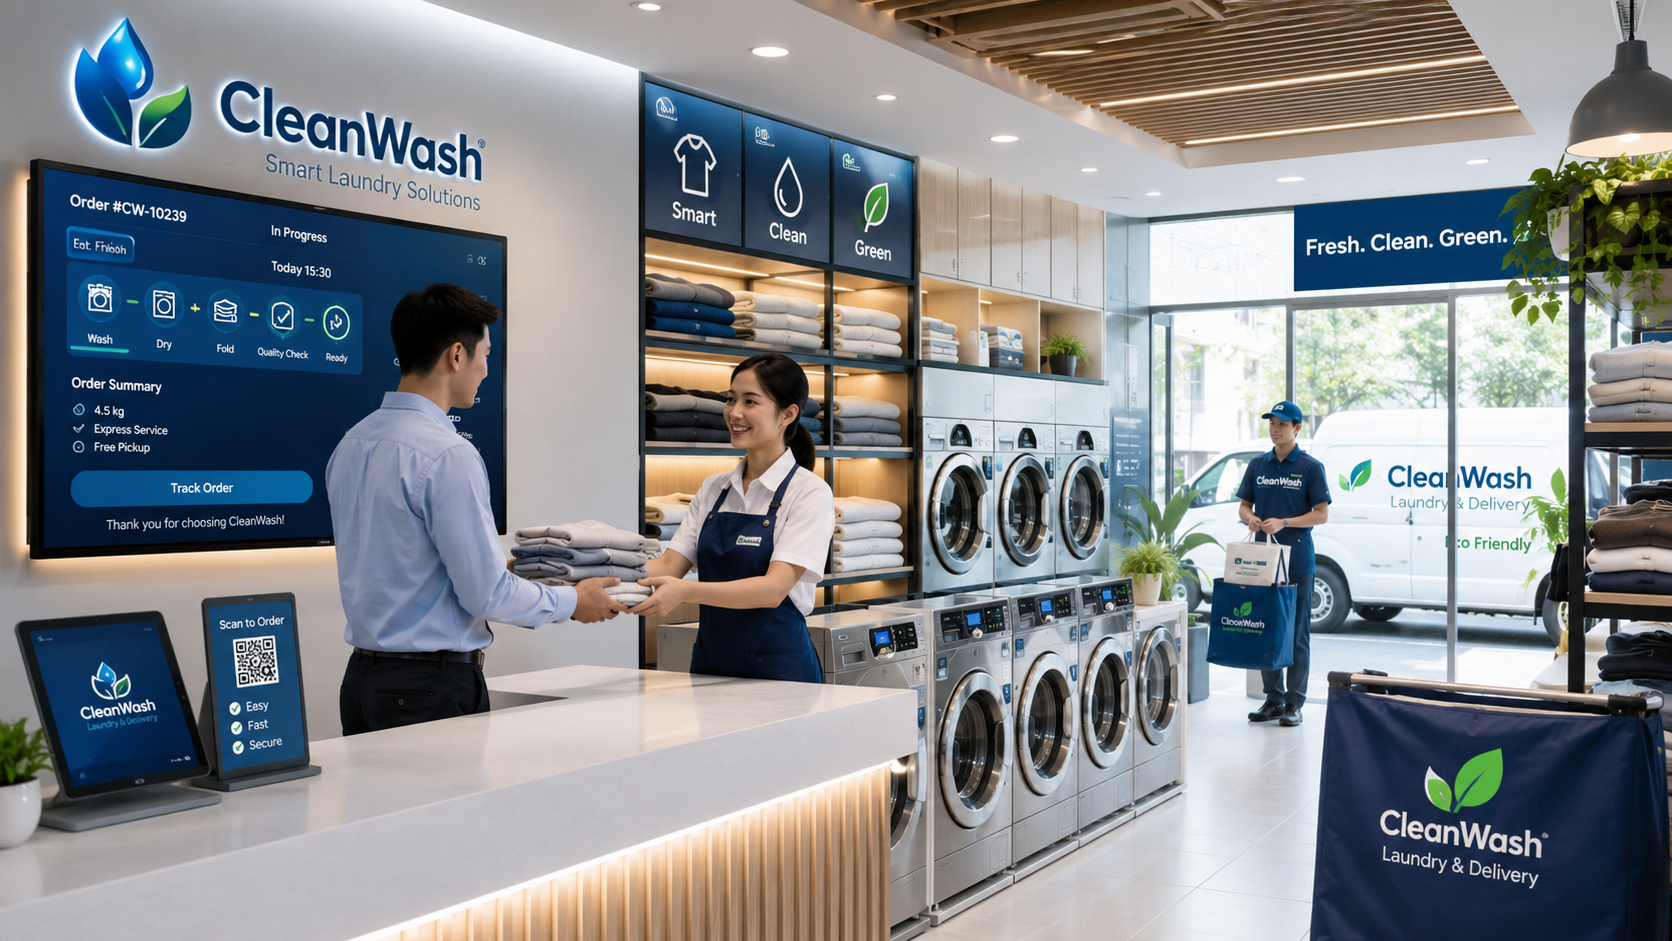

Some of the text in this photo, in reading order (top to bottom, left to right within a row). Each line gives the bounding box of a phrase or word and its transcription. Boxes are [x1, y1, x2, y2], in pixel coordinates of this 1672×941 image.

[266, 153, 481, 211] Smart Laundry Solutions
[69, 193, 187, 223] Order #CW-10239
[672, 201, 717, 227] Smart
[271, 224, 328, 244] In Progress
[769, 221, 807, 245] Clean
[1306, 228, 1508, 256] Fresh. Clean. Green.
[854, 239, 892, 262] Green
[271, 260, 332, 279] Today 15:30
[87, 333, 113, 345] Wash
[156, 338, 173, 351] Dry
[216, 343, 235, 354] Fold
[285, 348, 309, 360] Check
[325, 352, 349, 365] Ready
[71, 376, 163, 395] Order Summary
[93, 405, 125, 419] 4.5 kg
[94, 423, 169, 437] Express Service
[94, 441, 151, 455] Free Pickup
[170, 482, 234, 494] Track Order
[1390, 495, 1448, 512] Laundry
[1469, 496, 1530, 514] Delivery
[105, 514, 285, 532] Thank you for choosing CleanWash!
[1475, 536, 1532, 554] Friendly
[219, 615, 285, 630] Scan to Order
[80, 699, 157, 720] CleanWash
[245, 700, 269, 713] Easy
[247, 718, 269, 731] Fast
[249, 737, 283, 751] Secure
[1380, 809, 1543, 858] CleanWash
[1382, 846, 1539, 889] Laundry & Delivery
